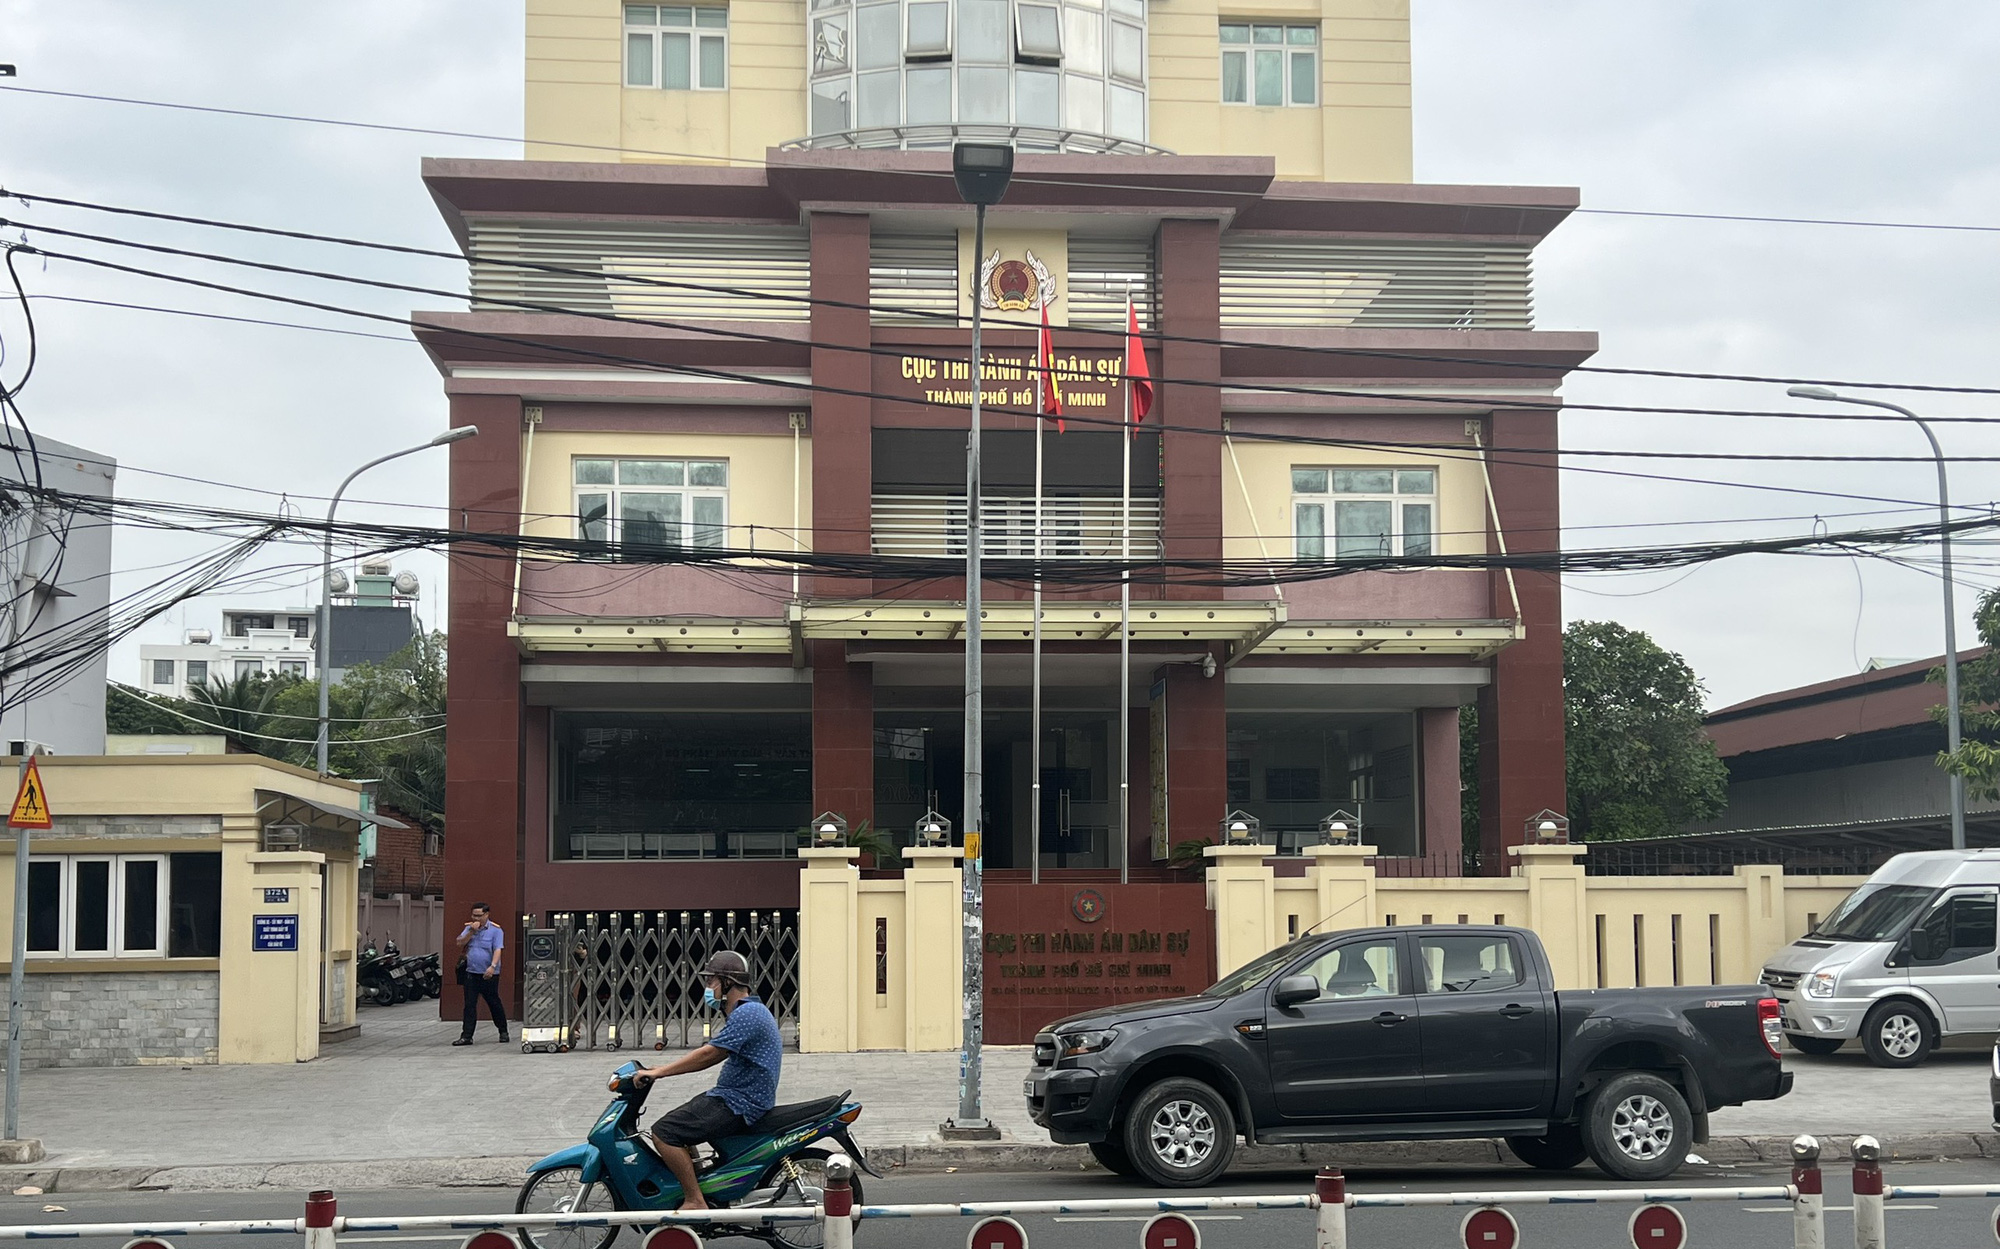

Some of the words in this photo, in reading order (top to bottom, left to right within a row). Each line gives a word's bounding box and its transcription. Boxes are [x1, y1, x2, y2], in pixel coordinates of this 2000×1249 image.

[902, 356, 937, 384] CỤC
[942, 357, 969, 380] THI
[1027, 354, 1039, 381] Á
[1056, 355, 1092, 382] DÂN
[1097, 356, 1122, 387] SỰ
[925, 387, 973, 405] THÀNH
[979, 387, 1008, 405] PHỐ
[1067, 392, 1107, 407] MINH
[985, 932, 1017, 958] CỤC
[1021, 932, 1046, 953] THI
[1051, 928, 1095, 953] HÀNH
[1101, 927, 1123, 953] ÁN
[1128, 929, 1161, 953] DÂN
[1166, 929, 1190, 957] SỰ
[1001, 961, 1046, 978] THÀNH
